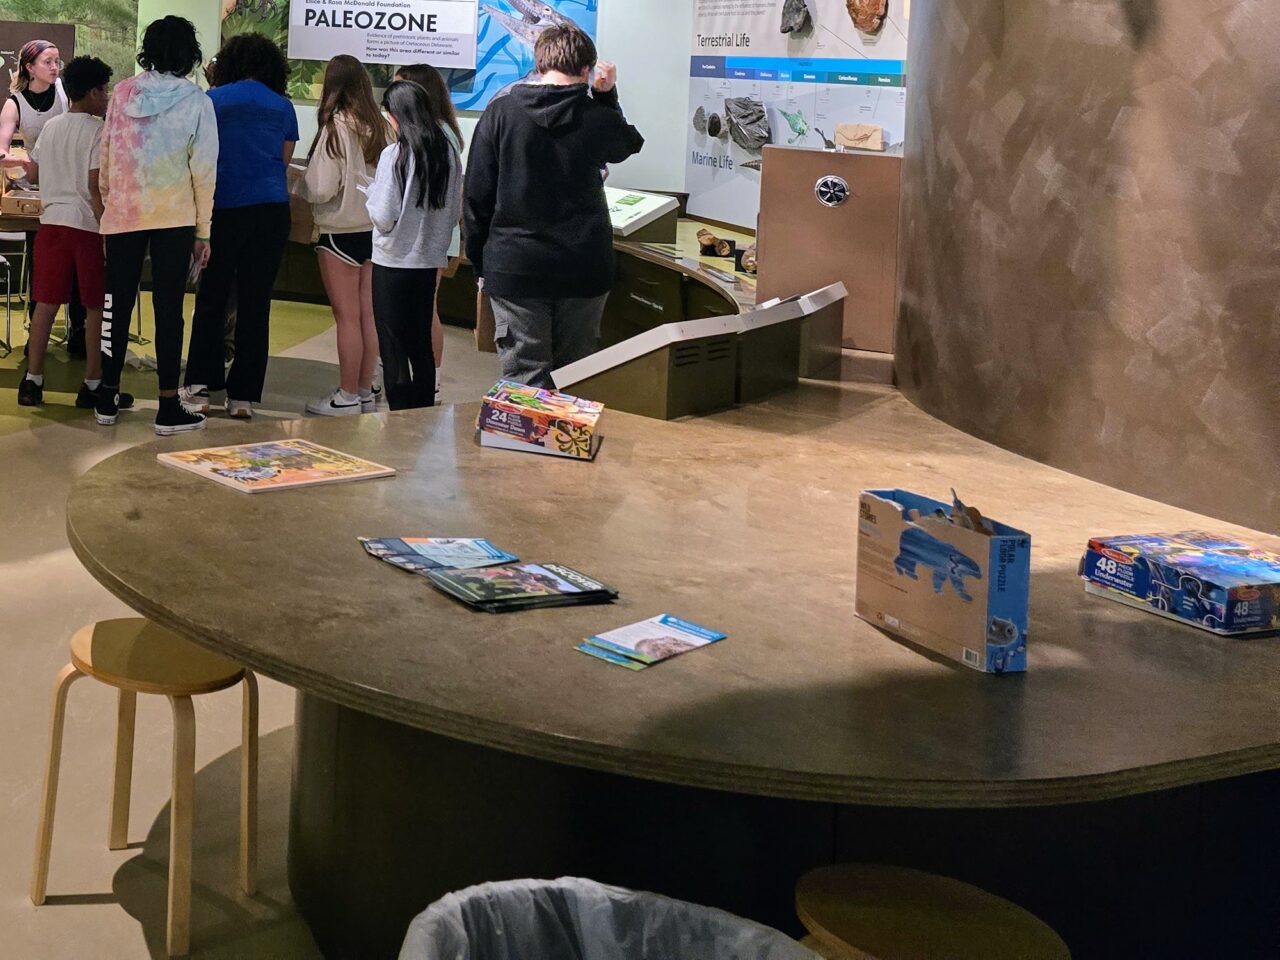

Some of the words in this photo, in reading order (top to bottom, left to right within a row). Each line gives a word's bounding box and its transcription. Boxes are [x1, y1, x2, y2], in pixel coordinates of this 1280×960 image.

[304, 8, 438, 33] PALEOZONE
[697, 32, 734, 47] Terrestrial
[736, 32, 750, 47] Life
[692, 151, 717, 168] Marine
[719, 155, 733, 170] Life
[491, 409, 507, 422] 24
[999, 539, 1008, 563] FLOOR
[1007, 539, 1016, 564] POLAR
[1096, 557, 1117, 575] 48
[997, 564, 1006, 593] PUZZLE
[1094, 568, 1134, 589] Underwater
[1234, 601, 1249, 616] 48
